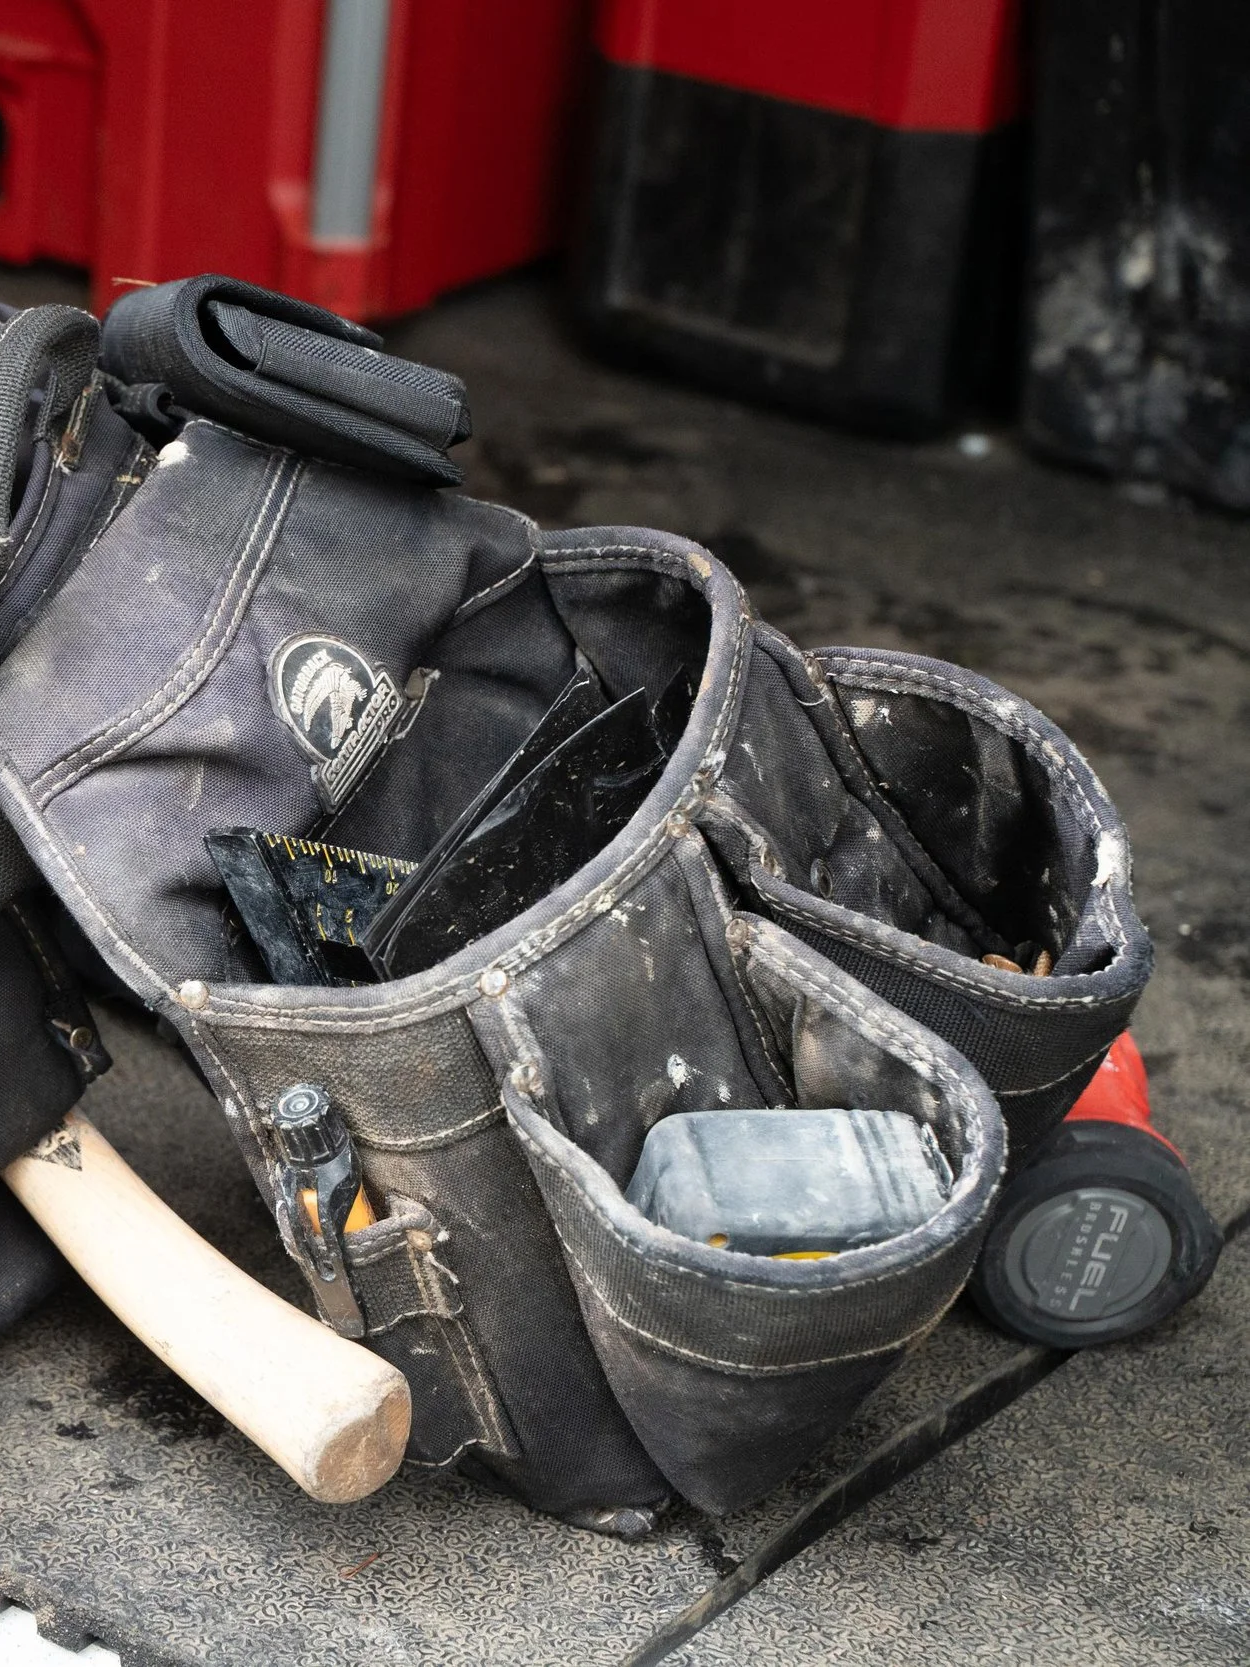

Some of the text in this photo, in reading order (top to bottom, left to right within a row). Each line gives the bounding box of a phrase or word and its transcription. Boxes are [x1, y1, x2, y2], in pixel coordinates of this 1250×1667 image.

[290, 649, 333, 715] GATORBACK
[375, 695, 398, 732] PRO
[326, 683, 391, 782] CONTRACTOR
[1050, 1201, 1102, 1309] BRUSHLESS
[1069, 1204, 1129, 1312] FUEL
